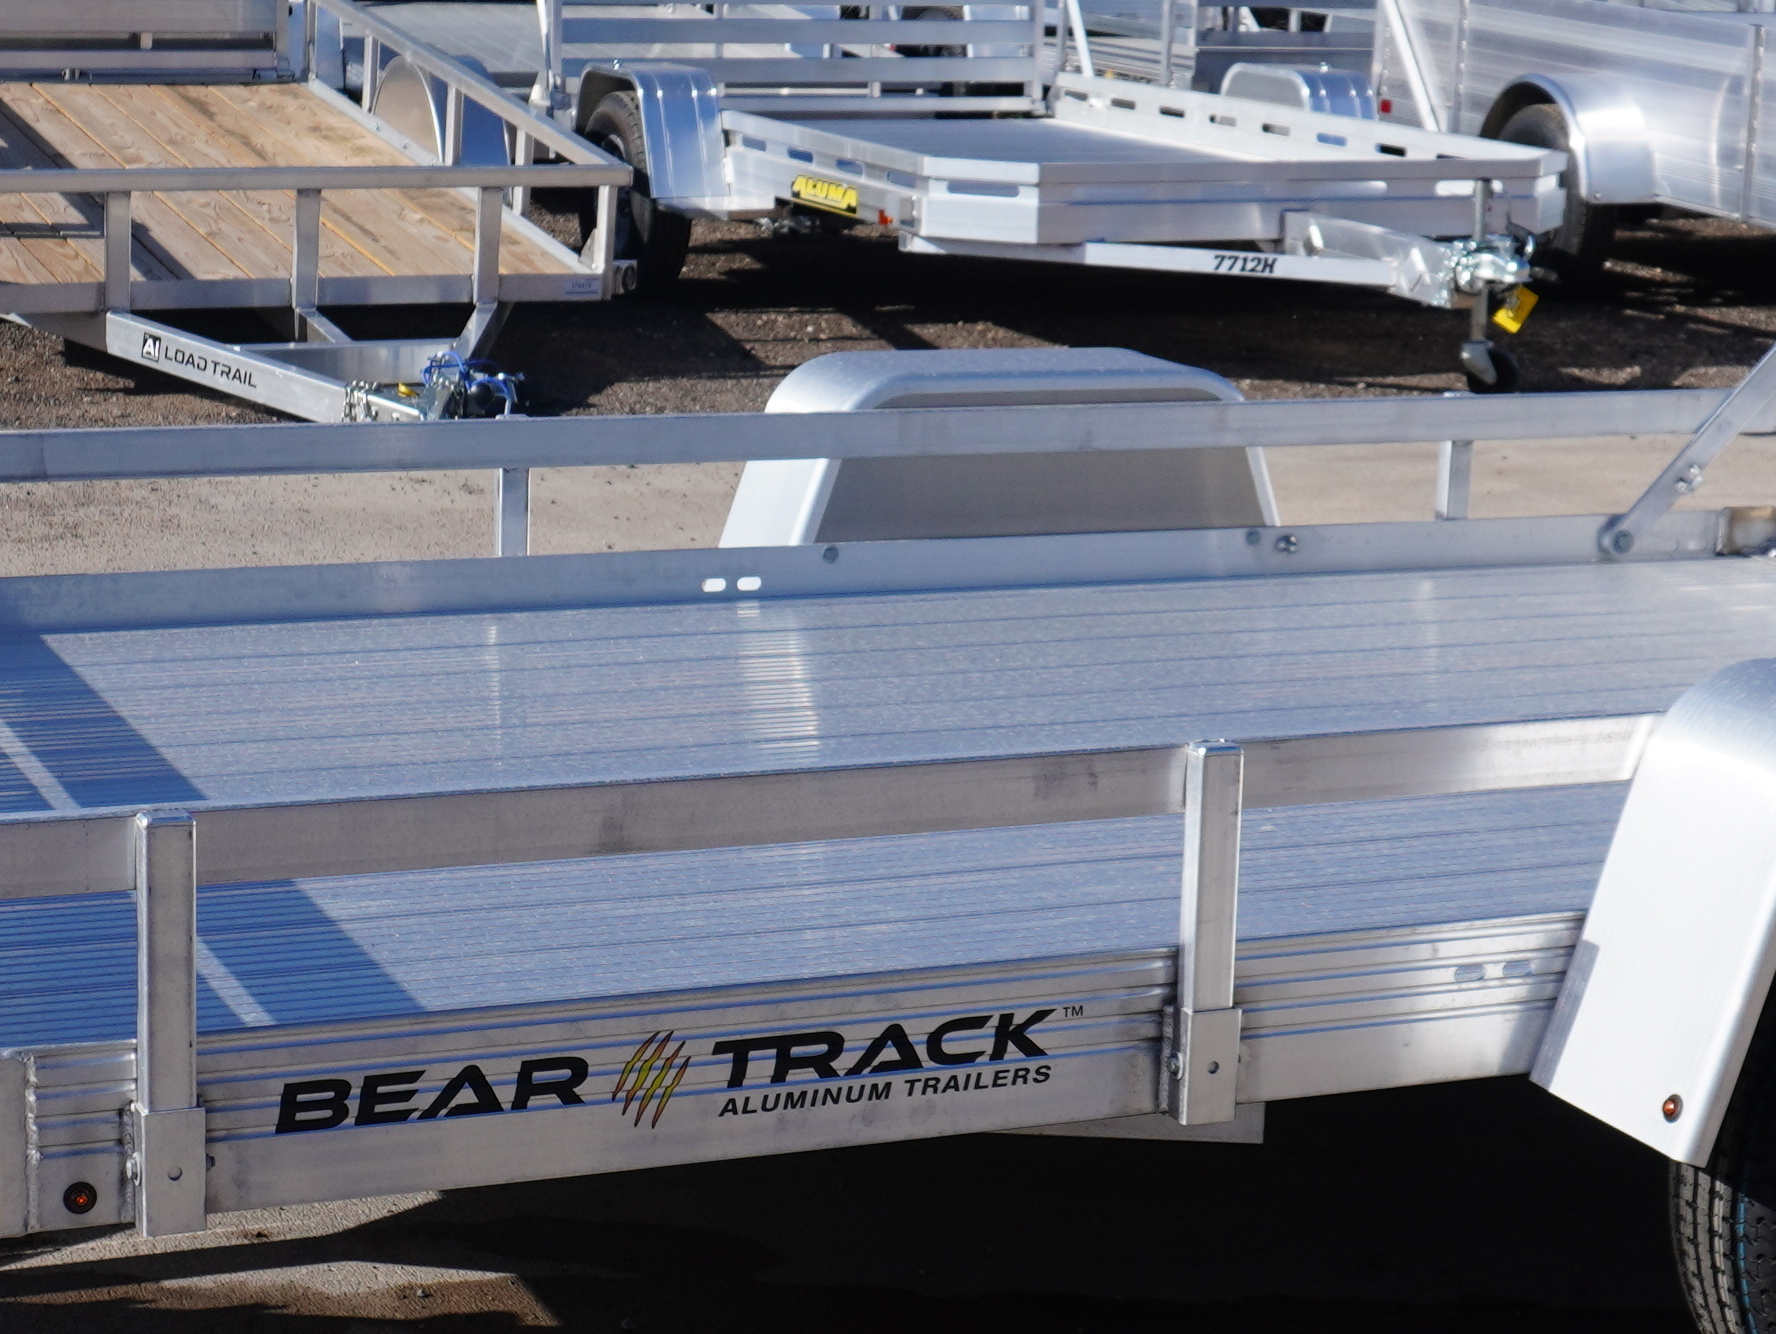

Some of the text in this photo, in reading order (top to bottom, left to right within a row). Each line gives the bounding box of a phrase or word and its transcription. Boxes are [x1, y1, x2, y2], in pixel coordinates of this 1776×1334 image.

[791, 174, 858, 210] ALUMA
[1213, 253, 1277, 274] 7712H
[165, 345, 208, 372] LOAD
[211, 360, 257, 389] TRAIL
[275, 1054, 590, 1135] BEAR
[712, 1007, 1058, 1089] TRACK
[718, 1064, 1054, 1119] ALUMINUM TRAILERS
